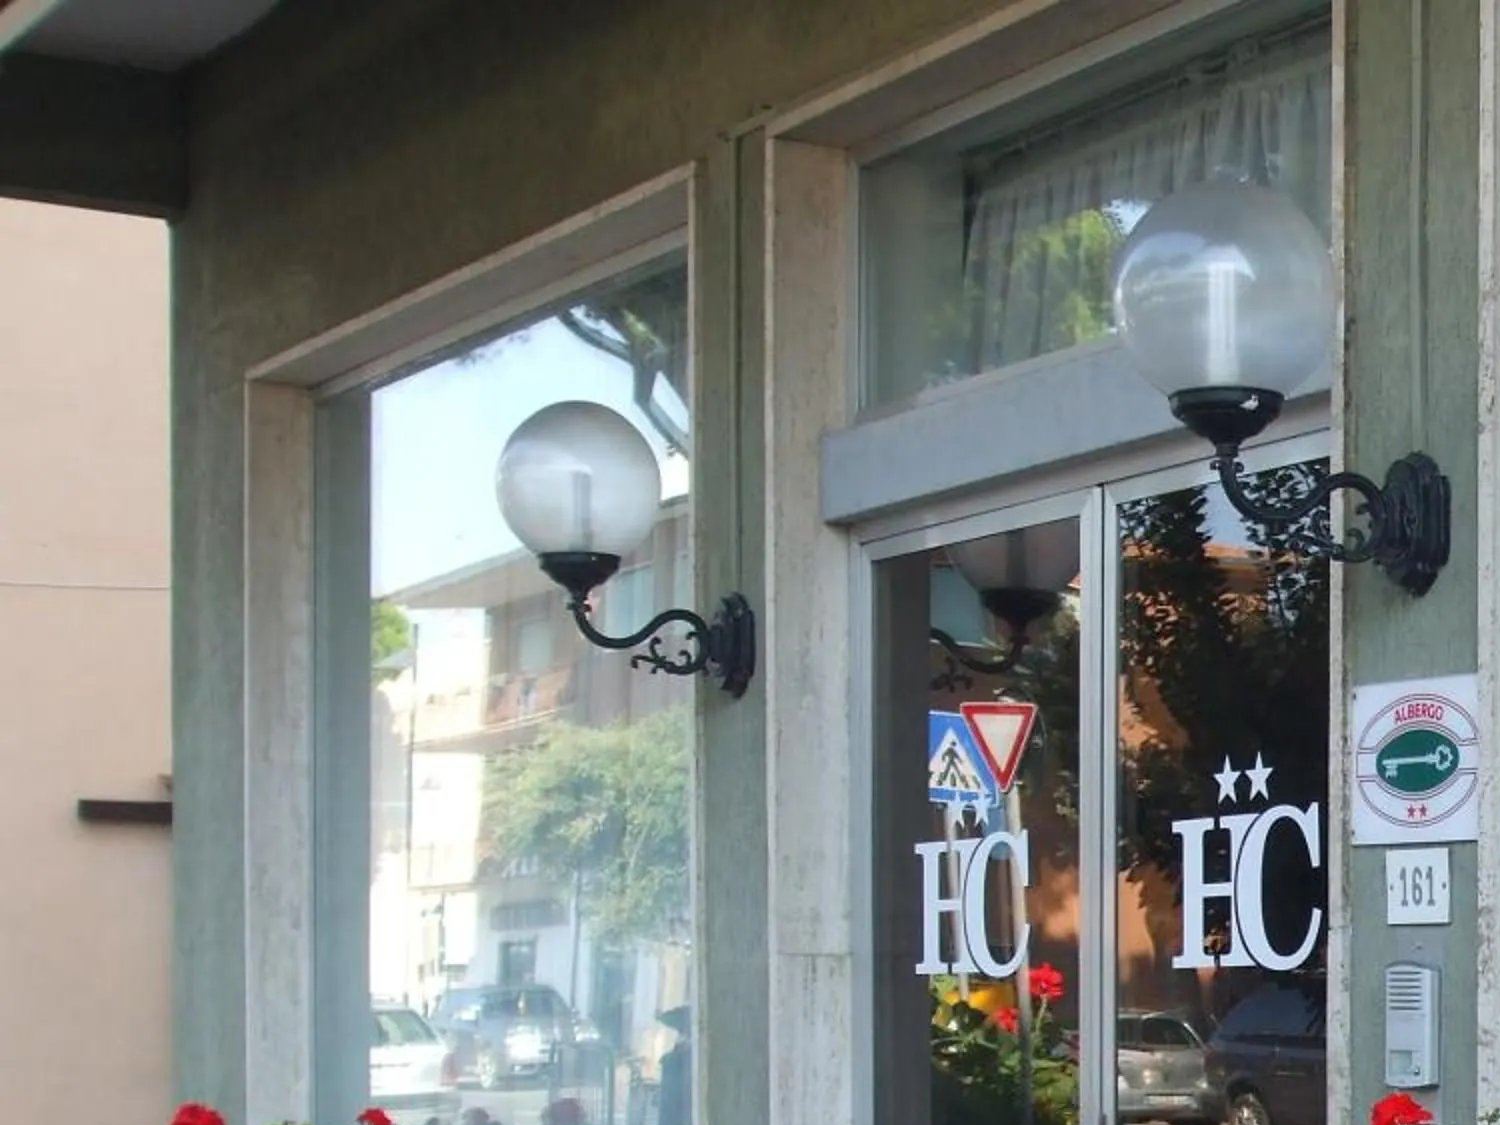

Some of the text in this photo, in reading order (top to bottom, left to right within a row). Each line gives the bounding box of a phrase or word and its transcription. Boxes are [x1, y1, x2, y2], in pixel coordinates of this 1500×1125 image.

[1393, 702, 1444, 722] ALBERGO
[914, 829, 1031, 979] HC
[1171, 801, 1322, 972] HC
[1400, 866, 1436, 907] 161
